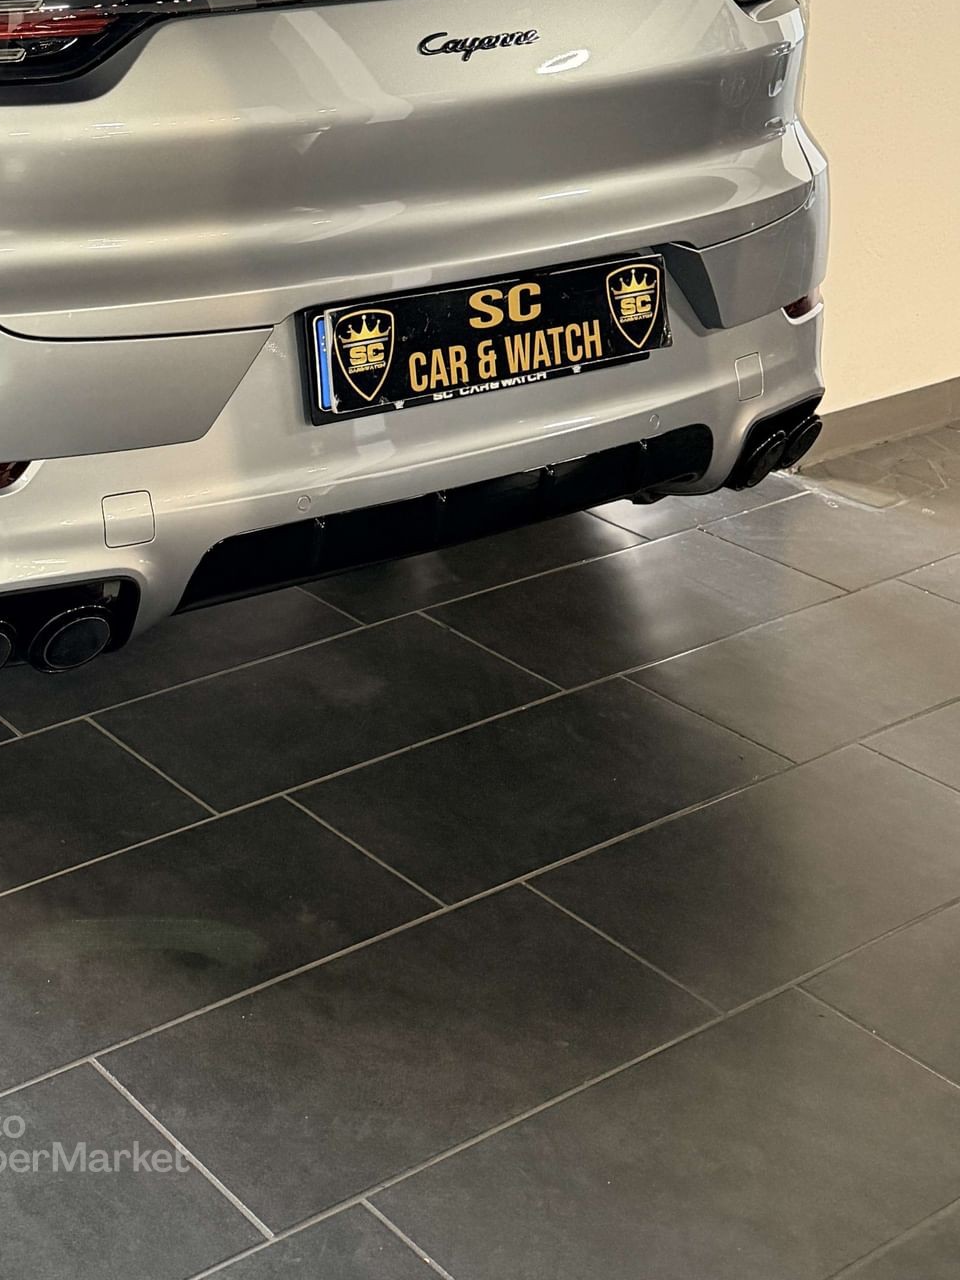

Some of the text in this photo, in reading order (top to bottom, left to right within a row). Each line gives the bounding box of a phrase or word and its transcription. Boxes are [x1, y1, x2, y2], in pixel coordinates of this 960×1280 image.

[418, 29, 540, 62] Cayenne
[469, 282, 542, 329] SC
[620, 294, 652, 316] SC
[349, 342, 385, 366] SC
[409, 320, 603, 393] CAR & WATCH
